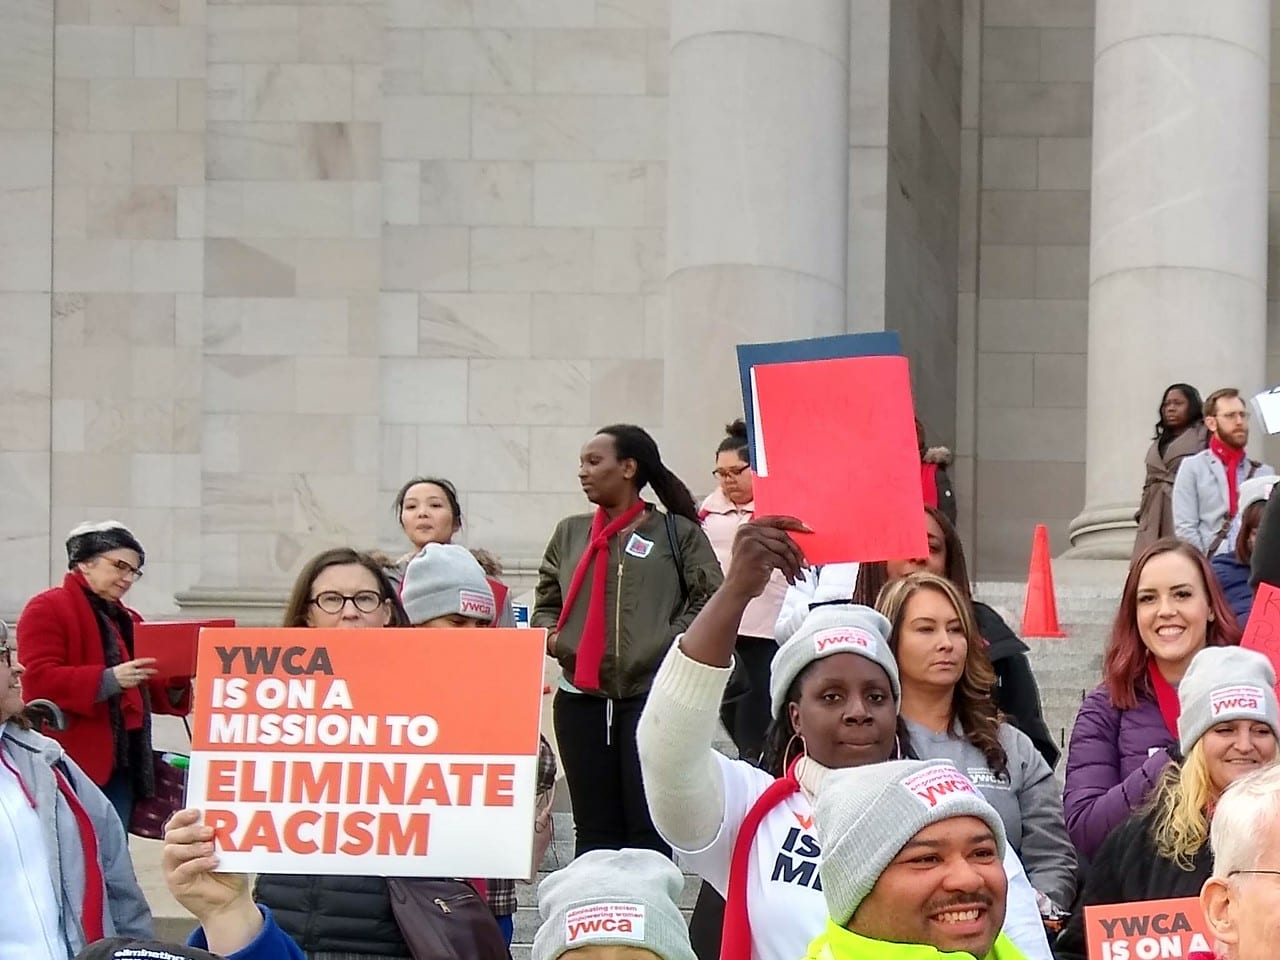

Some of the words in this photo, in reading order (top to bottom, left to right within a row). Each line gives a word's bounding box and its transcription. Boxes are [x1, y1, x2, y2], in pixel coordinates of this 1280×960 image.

[462, 601, 491, 615] ywca
[817, 635, 867, 651] ywca
[216, 646, 334, 675] YWCA
[212, 678, 247, 709] IS
[256, 679, 314, 709] ON
[322, 679, 353, 710] A
[1213, 698, 1258, 715] ywca
[209, 713, 377, 746] MISSION
[385, 715, 438, 746] TO
[206, 760, 514, 807] ELIMINATE
[203, 810, 430, 856] RACISM
[781, 827, 821, 857] IS
[568, 919, 632, 941] ywca
[1099, 913, 1192, 938] YWCA
[1135, 935, 1182, 960] ON
[1189, 933, 1211, 952] A
